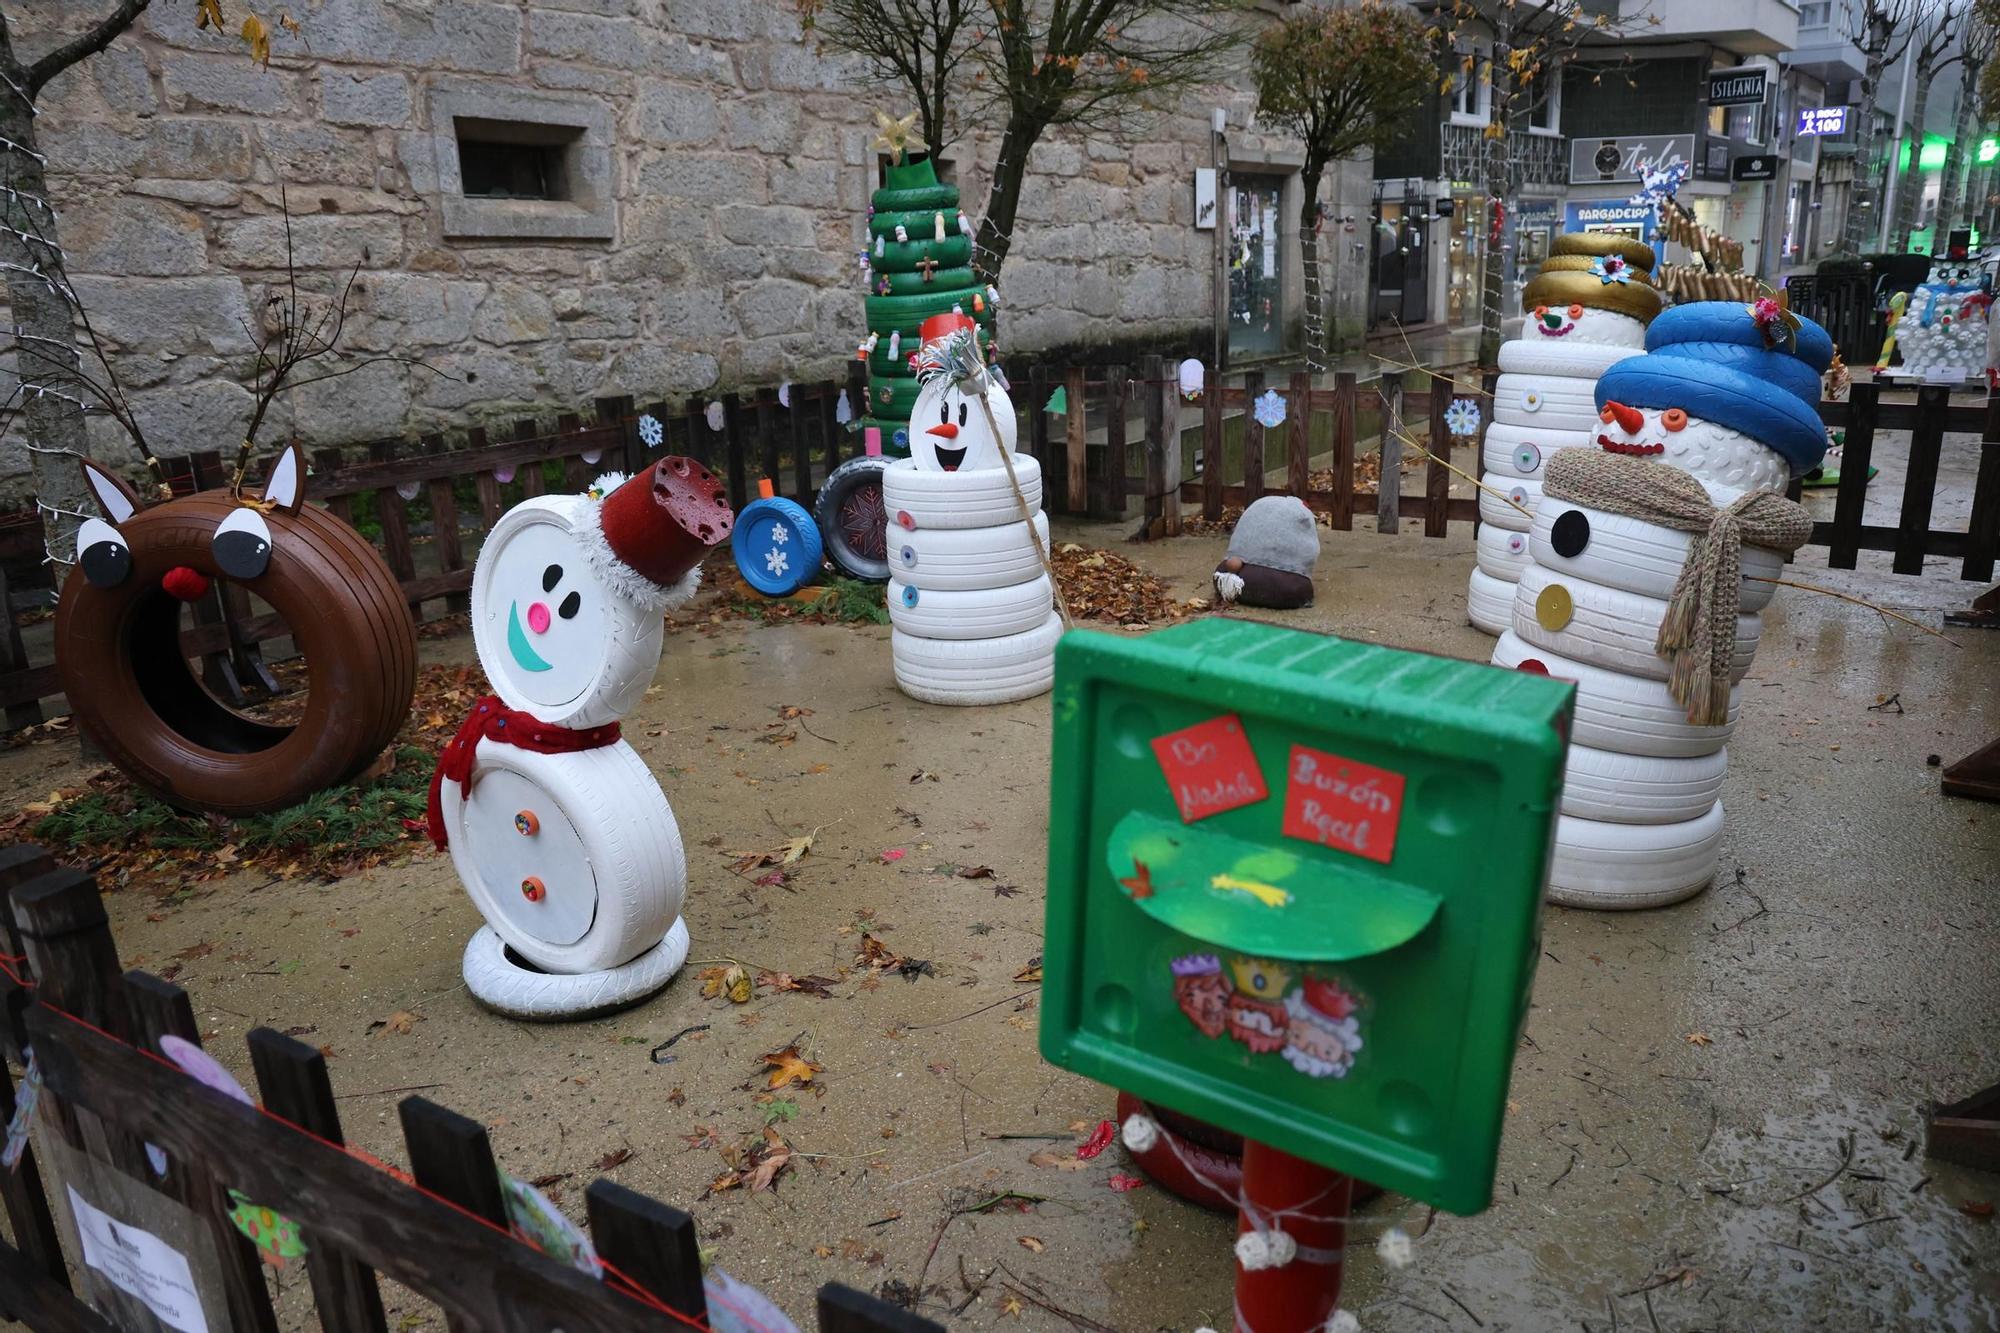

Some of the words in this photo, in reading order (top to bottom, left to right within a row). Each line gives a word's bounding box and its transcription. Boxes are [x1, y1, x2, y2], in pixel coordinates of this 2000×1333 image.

[1802, 110, 1815, 120] LA
[1578, 207, 1650, 221] SARGADELOS
[1171, 738, 1217, 766] Bo
[1295, 752, 1391, 813] Buzón
[1302, 798, 1370, 850] Real
